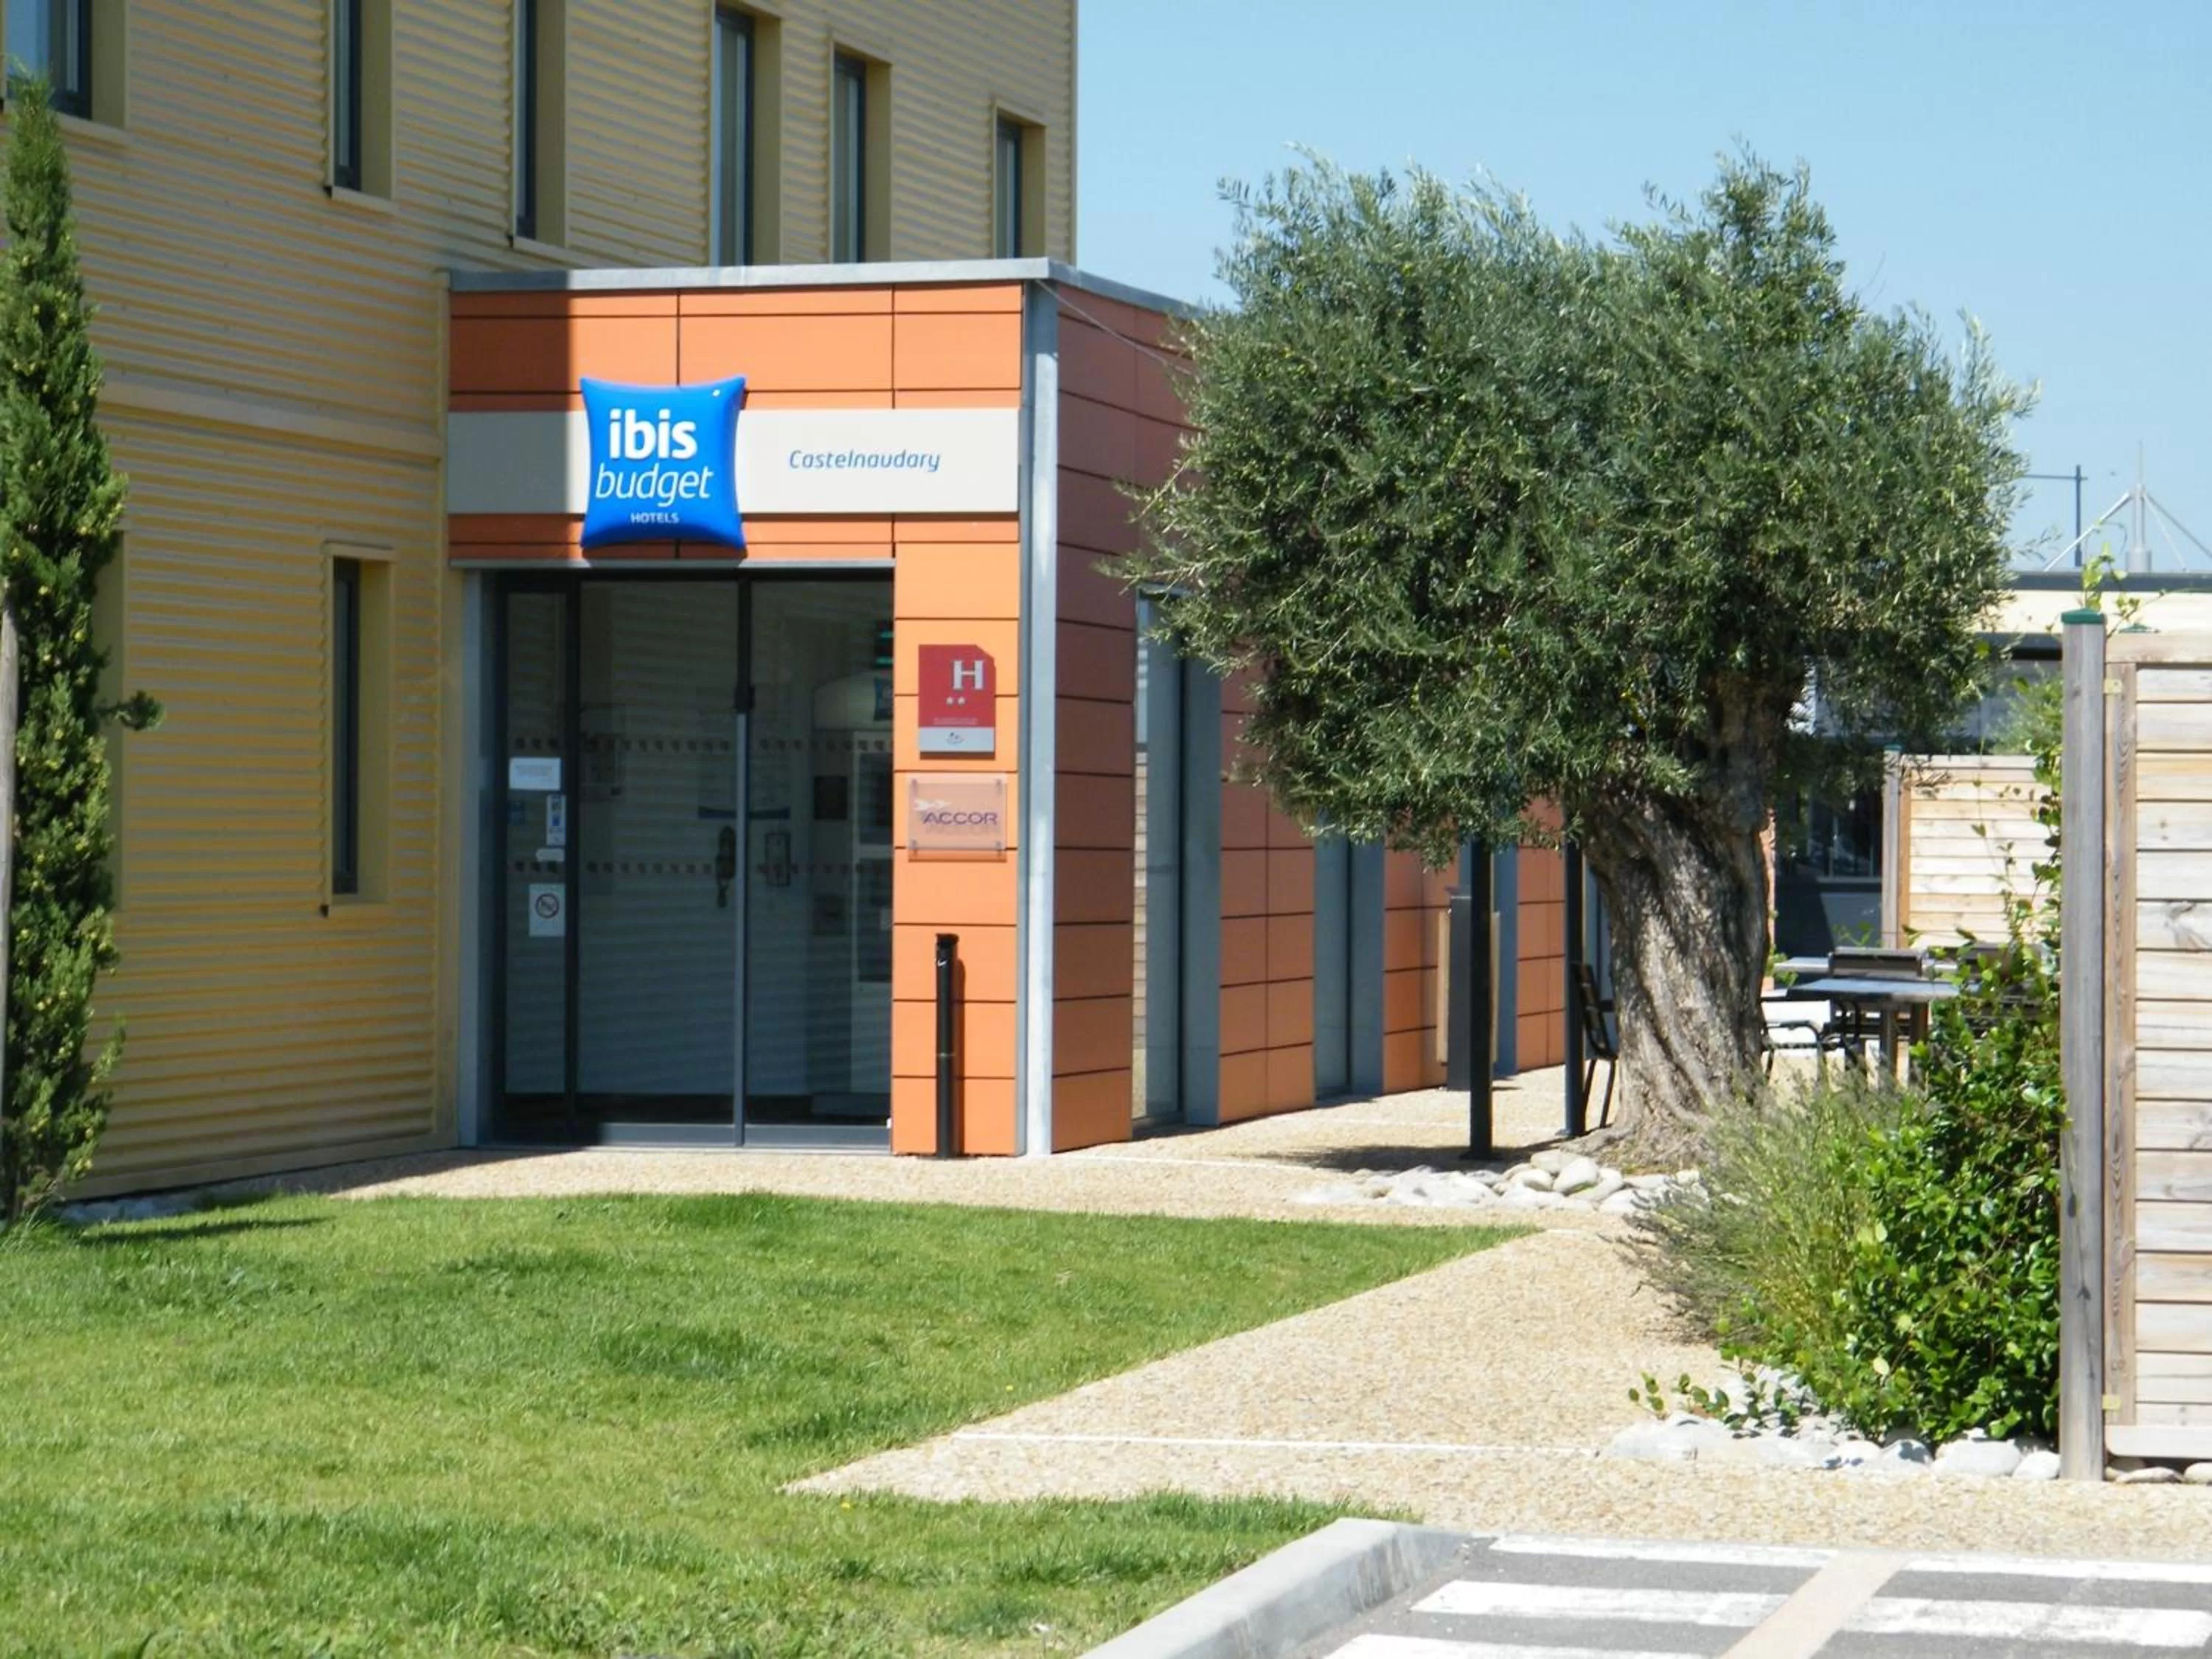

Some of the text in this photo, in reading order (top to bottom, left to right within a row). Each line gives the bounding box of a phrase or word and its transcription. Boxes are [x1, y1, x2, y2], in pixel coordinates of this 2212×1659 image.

[610, 409, 697, 460] ibis
[789, 450, 941, 473] Castelnaudary
[595, 464, 713, 507] budget
[631, 512, 680, 524] HOTELS
[953, 660, 984, 690] H
[923, 812, 998, 825] ACCOR
